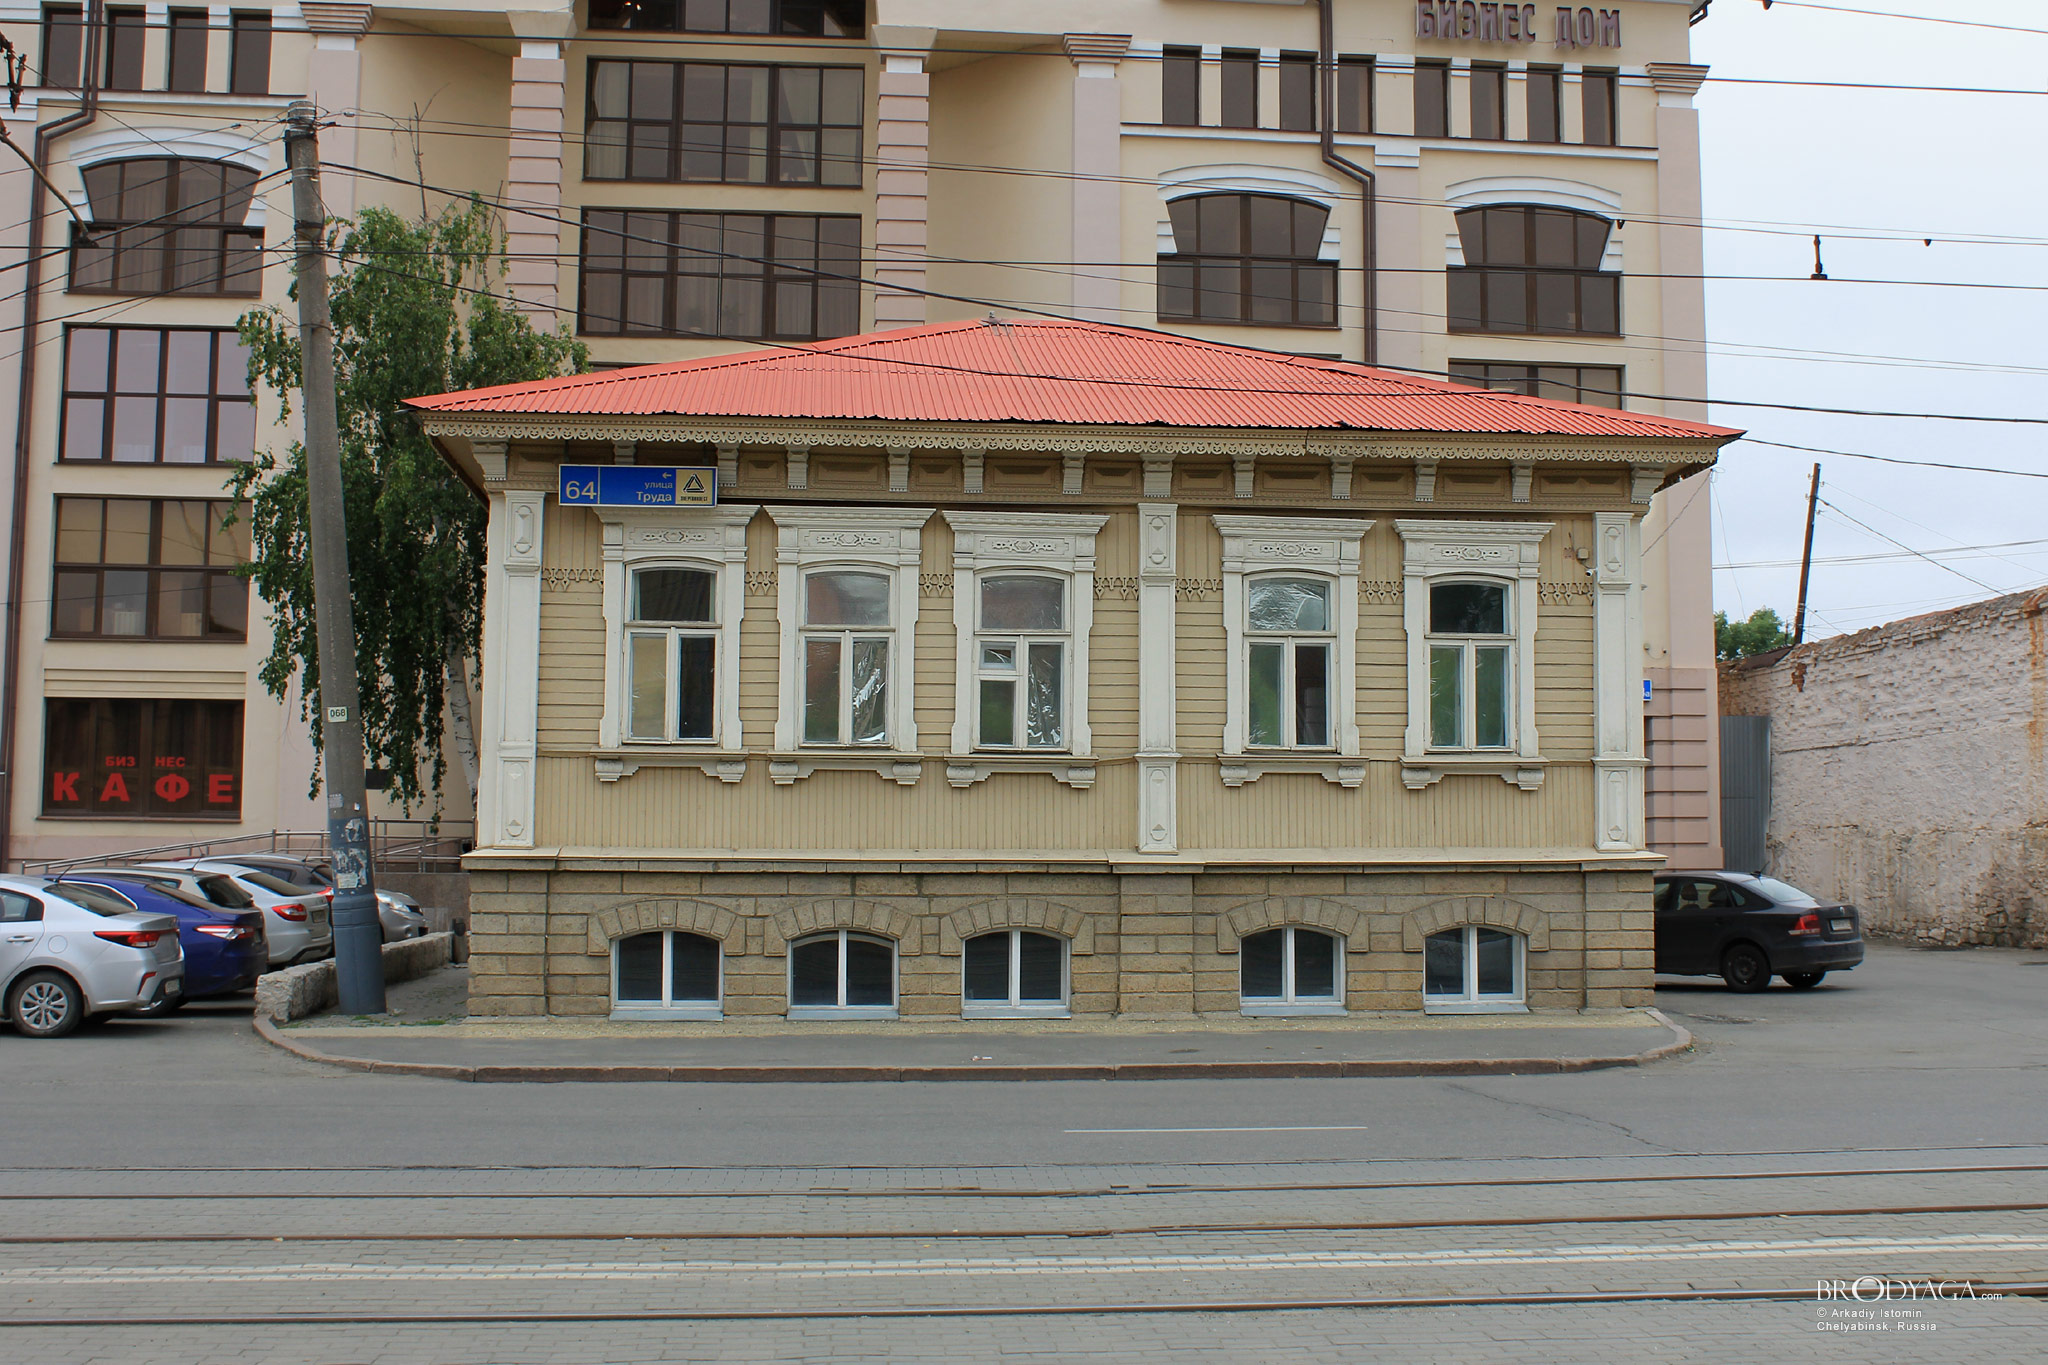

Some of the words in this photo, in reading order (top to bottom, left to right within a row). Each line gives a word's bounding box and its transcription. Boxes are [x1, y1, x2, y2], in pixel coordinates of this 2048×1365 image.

[1416, 0, 1536, 42] БИЗНЕС
[1554, 7, 1622, 49] ДОМ
[565, 480, 597, 500] 64
[644, 481, 673, 490] улица
[637, 491, 672, 503] Труда
[330, 709, 346, 717] 068
[53, 772, 234, 803] КАФЕ
